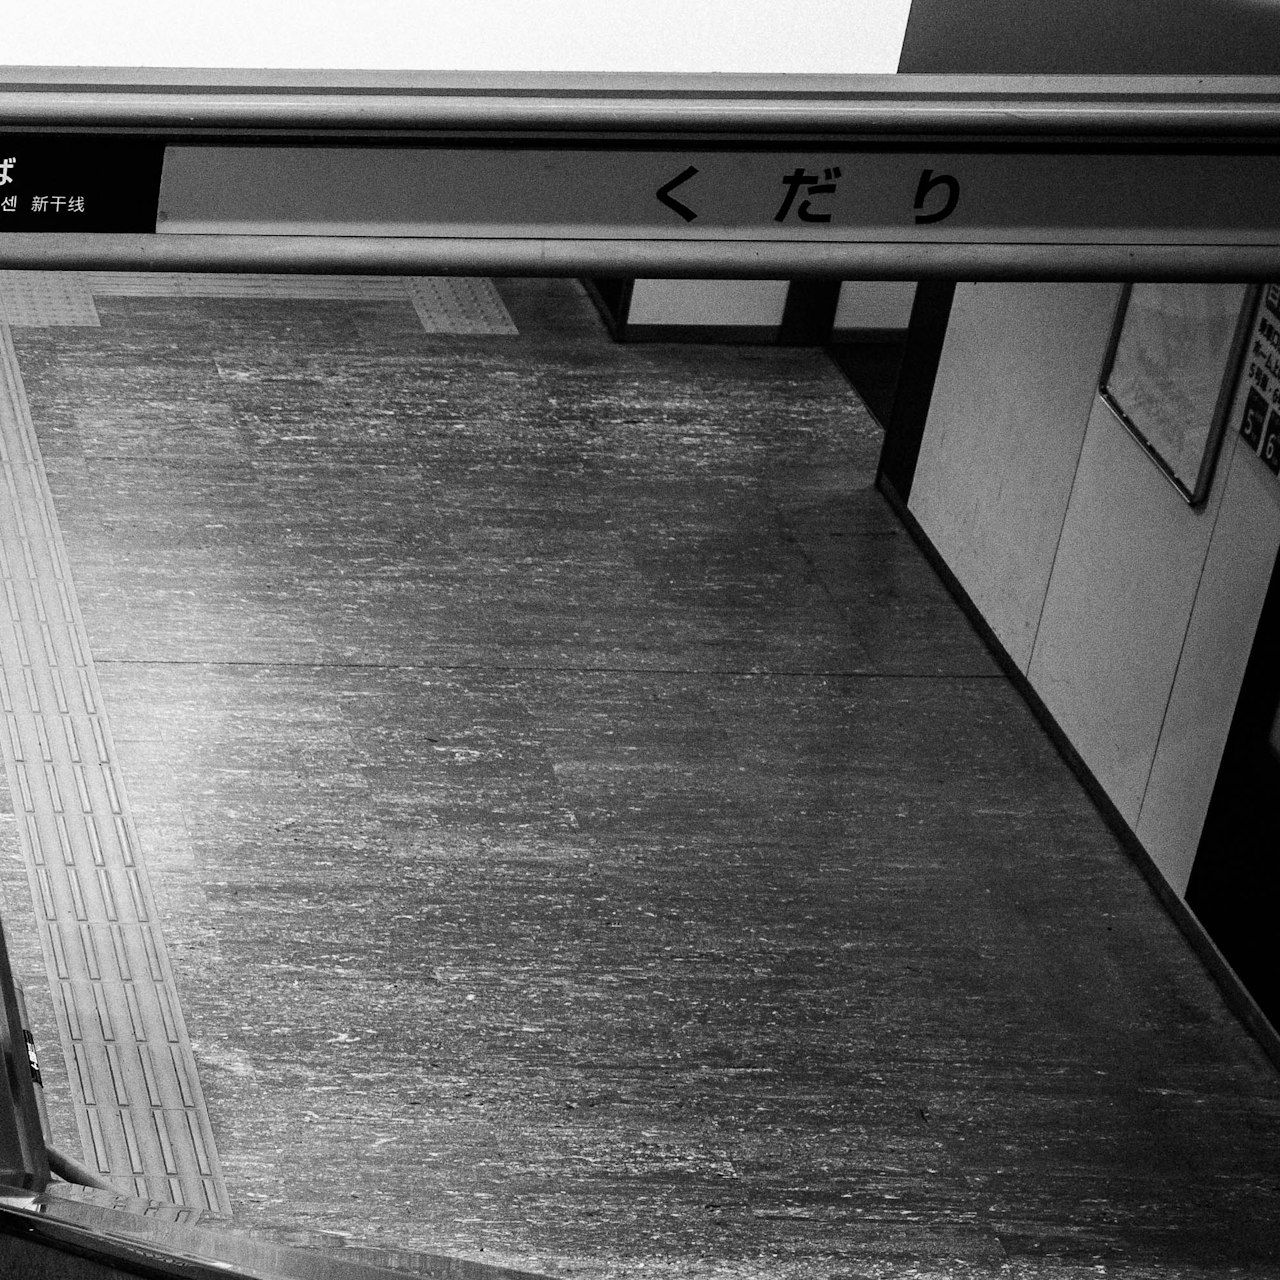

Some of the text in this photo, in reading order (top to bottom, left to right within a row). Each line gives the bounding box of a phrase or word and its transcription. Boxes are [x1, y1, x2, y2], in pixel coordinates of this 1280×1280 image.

[30, 195, 85, 213] 新干线
[1244, 408, 1255, 436] 5
[1265, 433, 1277, 459] 6
